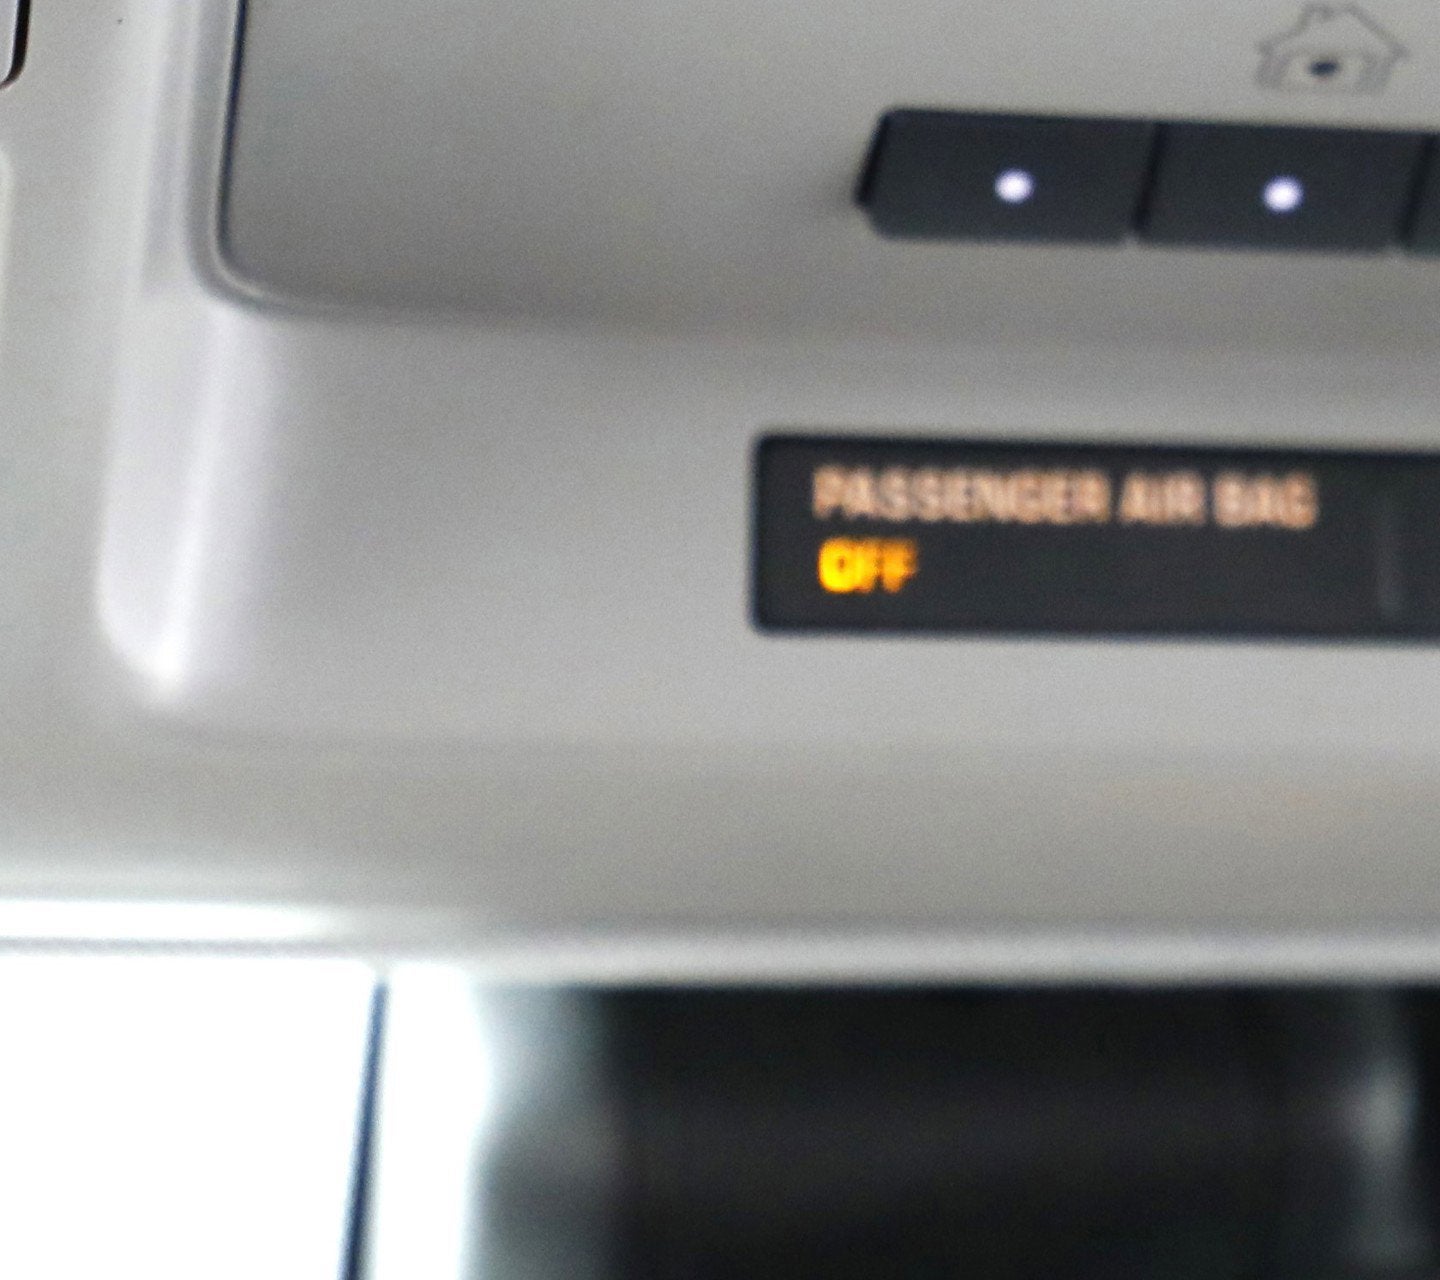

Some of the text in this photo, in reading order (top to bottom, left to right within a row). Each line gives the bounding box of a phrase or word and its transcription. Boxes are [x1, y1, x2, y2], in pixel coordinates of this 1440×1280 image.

[811, 464, 1319, 530] PASSENGER AIR BAG
[817, 536, 919, 594] OFF
